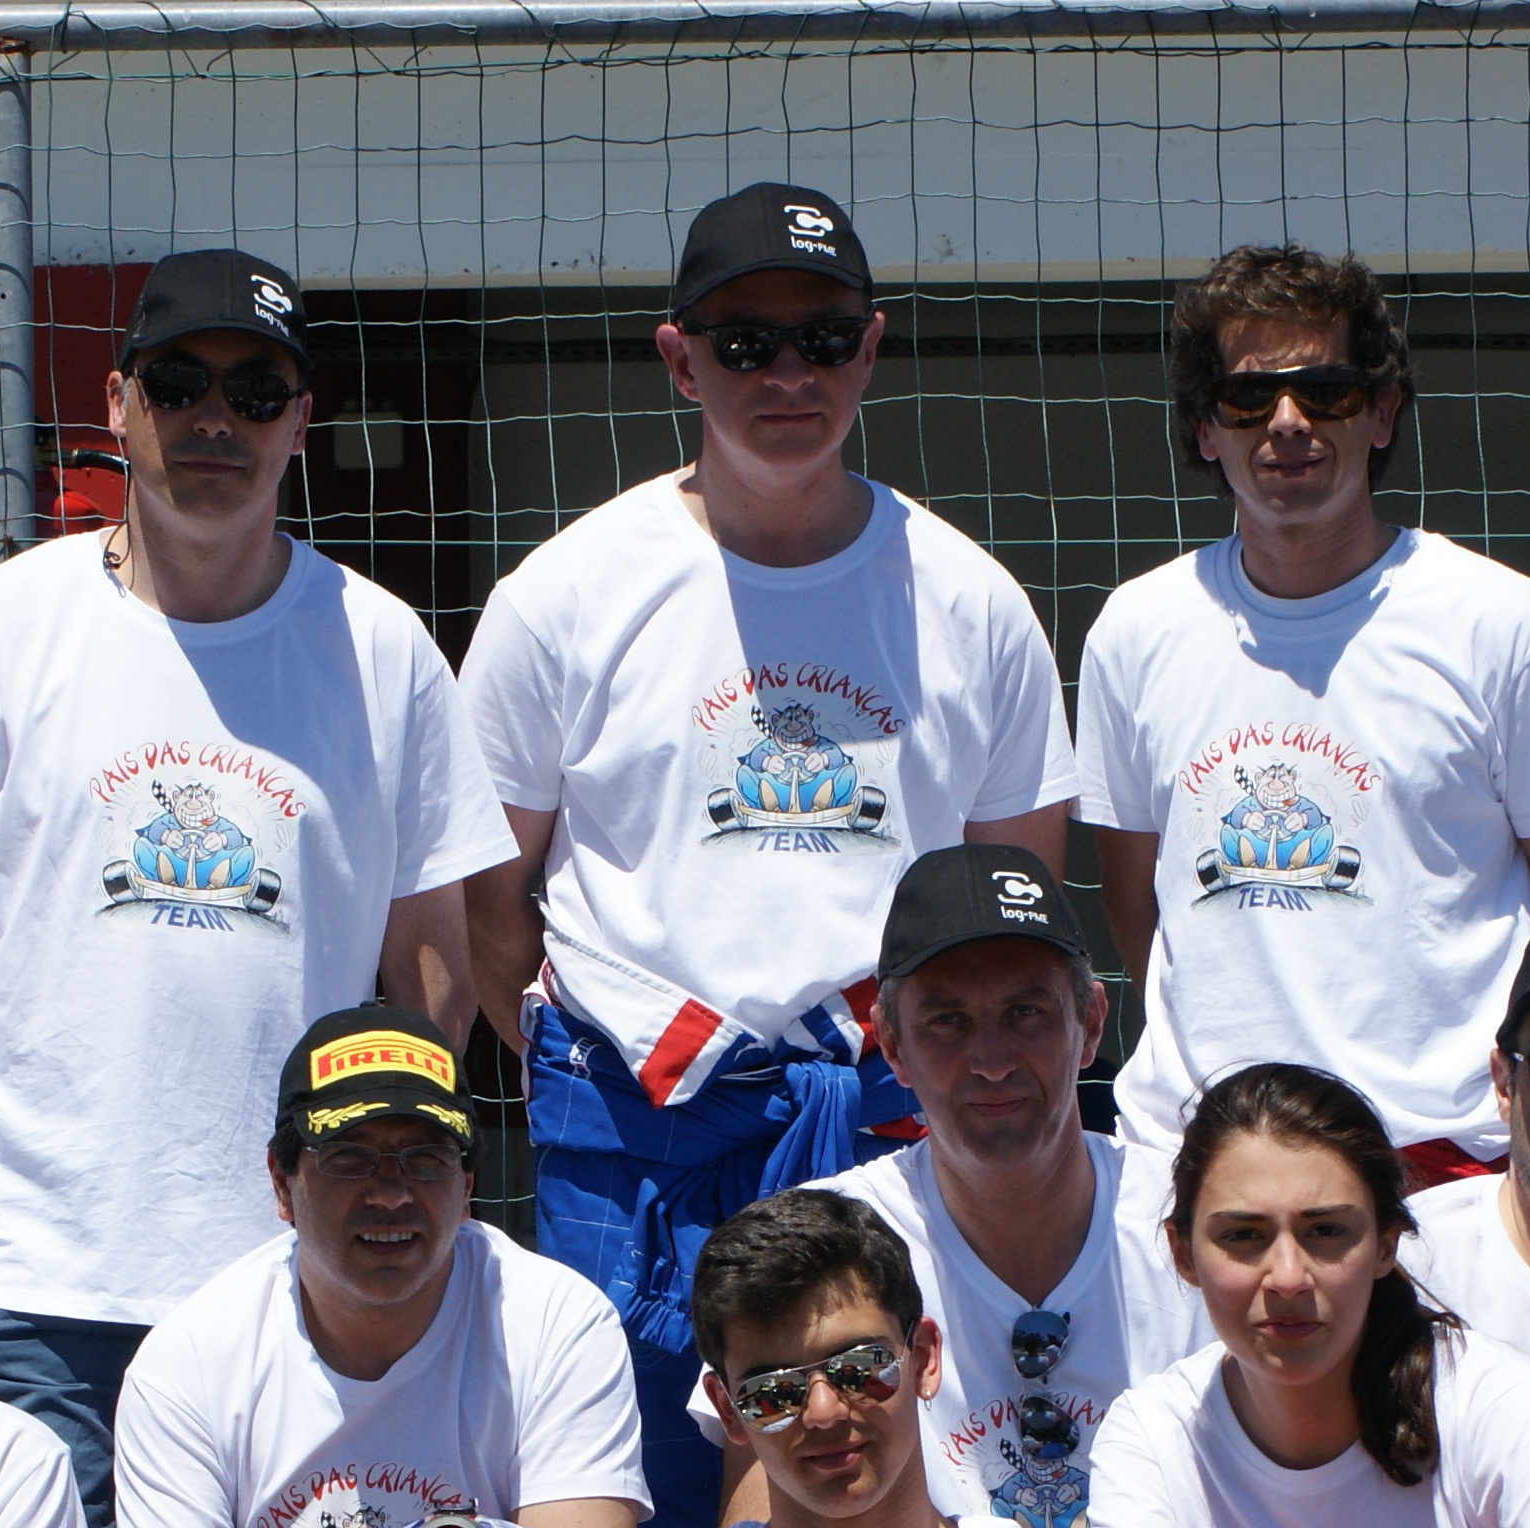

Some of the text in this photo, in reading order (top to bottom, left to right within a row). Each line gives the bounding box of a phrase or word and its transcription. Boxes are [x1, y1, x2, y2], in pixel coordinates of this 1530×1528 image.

[692, 663, 906, 734] PAIS DAS CRIANÇAS
[90, 741, 306, 817] PAIS DAS CRIANÇAS
[1178, 721, 1381, 794] PAIS DAS CRIANÇAS
[756, 831, 841, 853] TEAM
[151, 905, 235, 931] TEAM
[1238, 887, 1313, 911] TEAM
[317, 1038, 448, 1082] PIRELLI
[939, 1412, 986, 1466] PAIS
[982, 1394, 1023, 1429] DA
[302, 1463, 357, 1501] DAS
[365, 1462, 462, 1512] CRIANÇA
